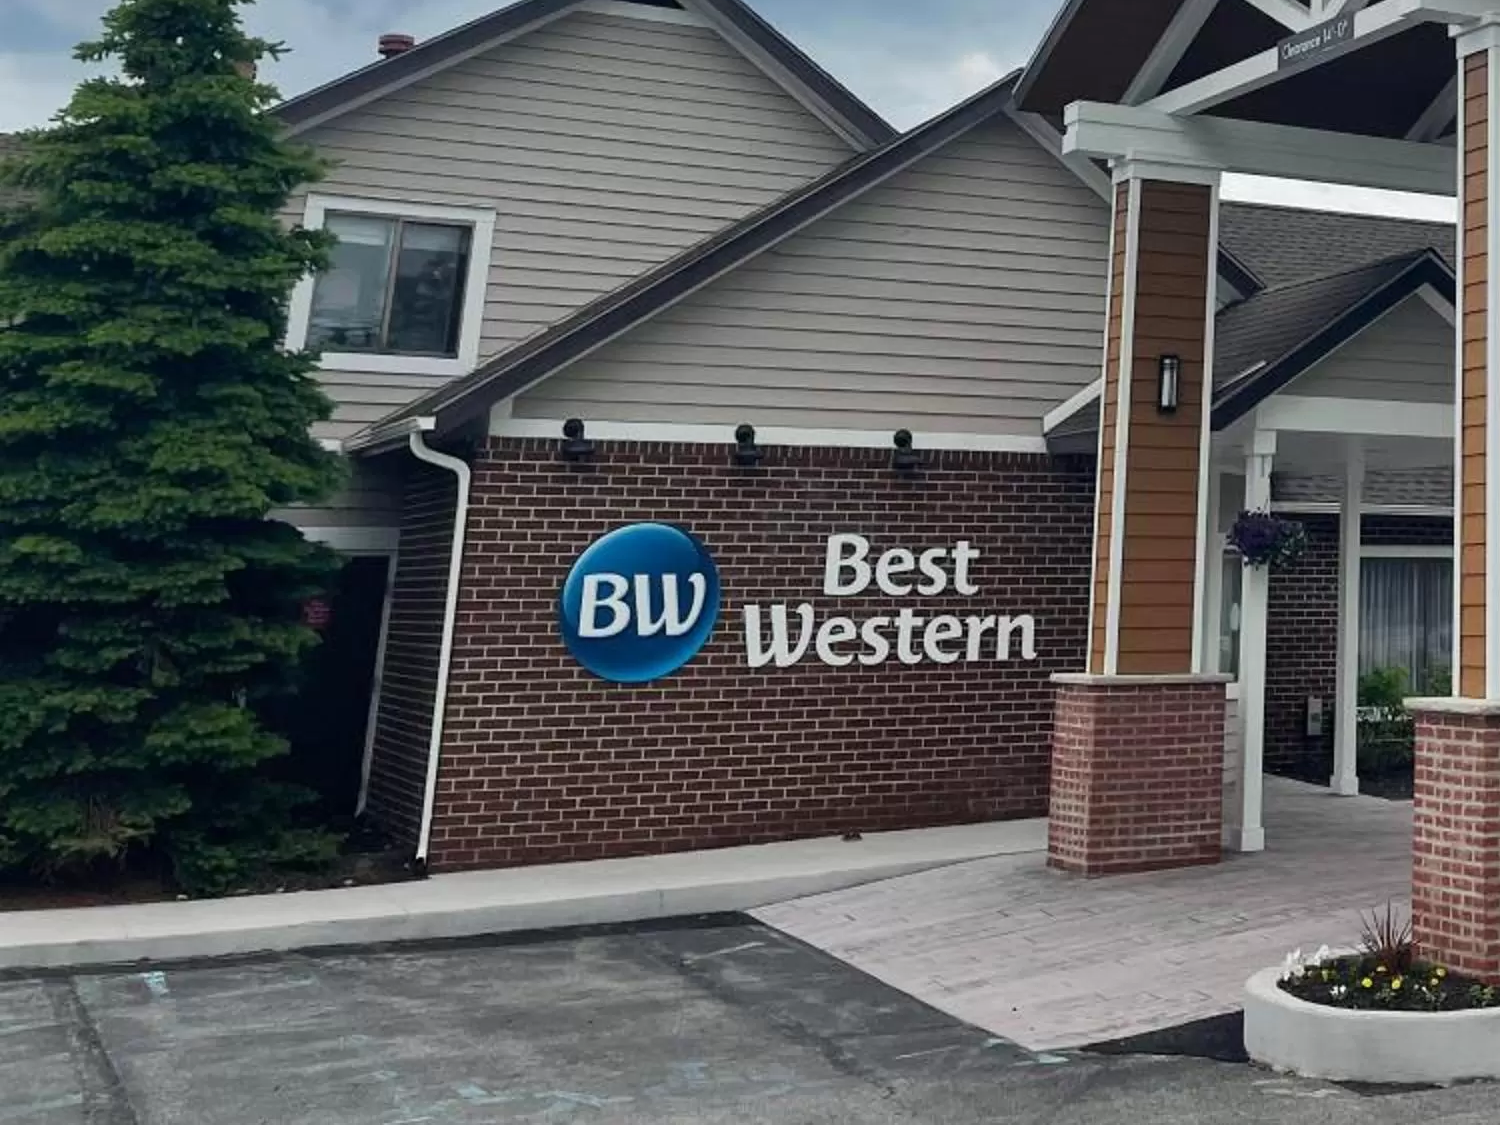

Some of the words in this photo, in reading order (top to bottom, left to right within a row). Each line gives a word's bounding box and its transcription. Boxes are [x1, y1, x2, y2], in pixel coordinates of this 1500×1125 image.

[823, 533, 980, 597] Best
[577, 572, 706, 638] BW
[743, 602, 1037, 668] Western
